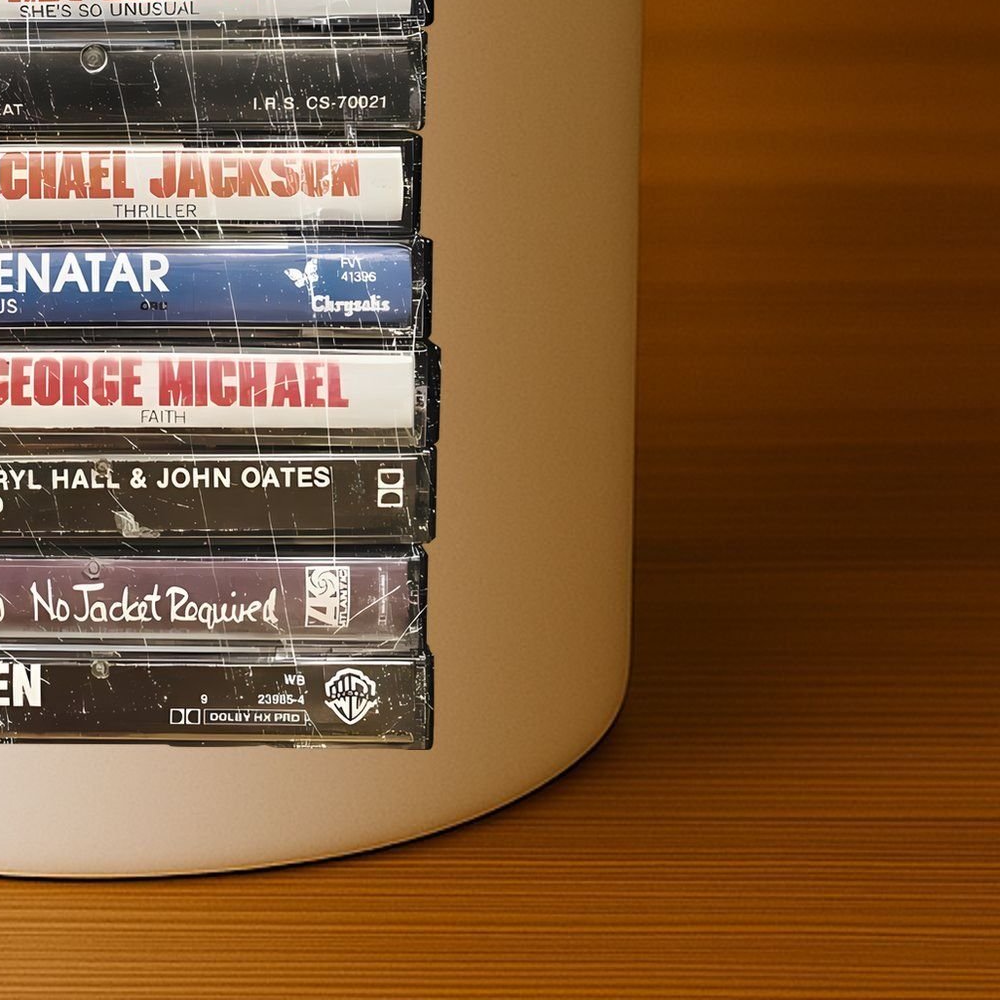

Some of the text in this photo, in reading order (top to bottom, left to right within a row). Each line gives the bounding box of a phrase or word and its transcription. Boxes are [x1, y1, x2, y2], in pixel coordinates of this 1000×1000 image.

[19, 1, 200, 19] SHE'S SO UNUSUAL
[306, 94, 387, 112] CS-70021
[150, 149, 360, 198] JACKSON
[112, 203, 197, 219] THRILLER
[312, 294, 390, 317] Chrysalis
[158, 358, 349, 407] MICHAEL
[140, 409, 186, 424] FAITH
[52, 468, 120, 490] HALL
[130, 467, 147, 489] &
[157, 467, 231, 489] JOHN
[241, 466, 331, 488] OATES
[30, 579, 70, 623] No
[72, 583, 161, 623] Jacket
[166, 585, 279, 630] Required
[201, 694, 208, 704] 9
[254, 712, 271, 722] HX
